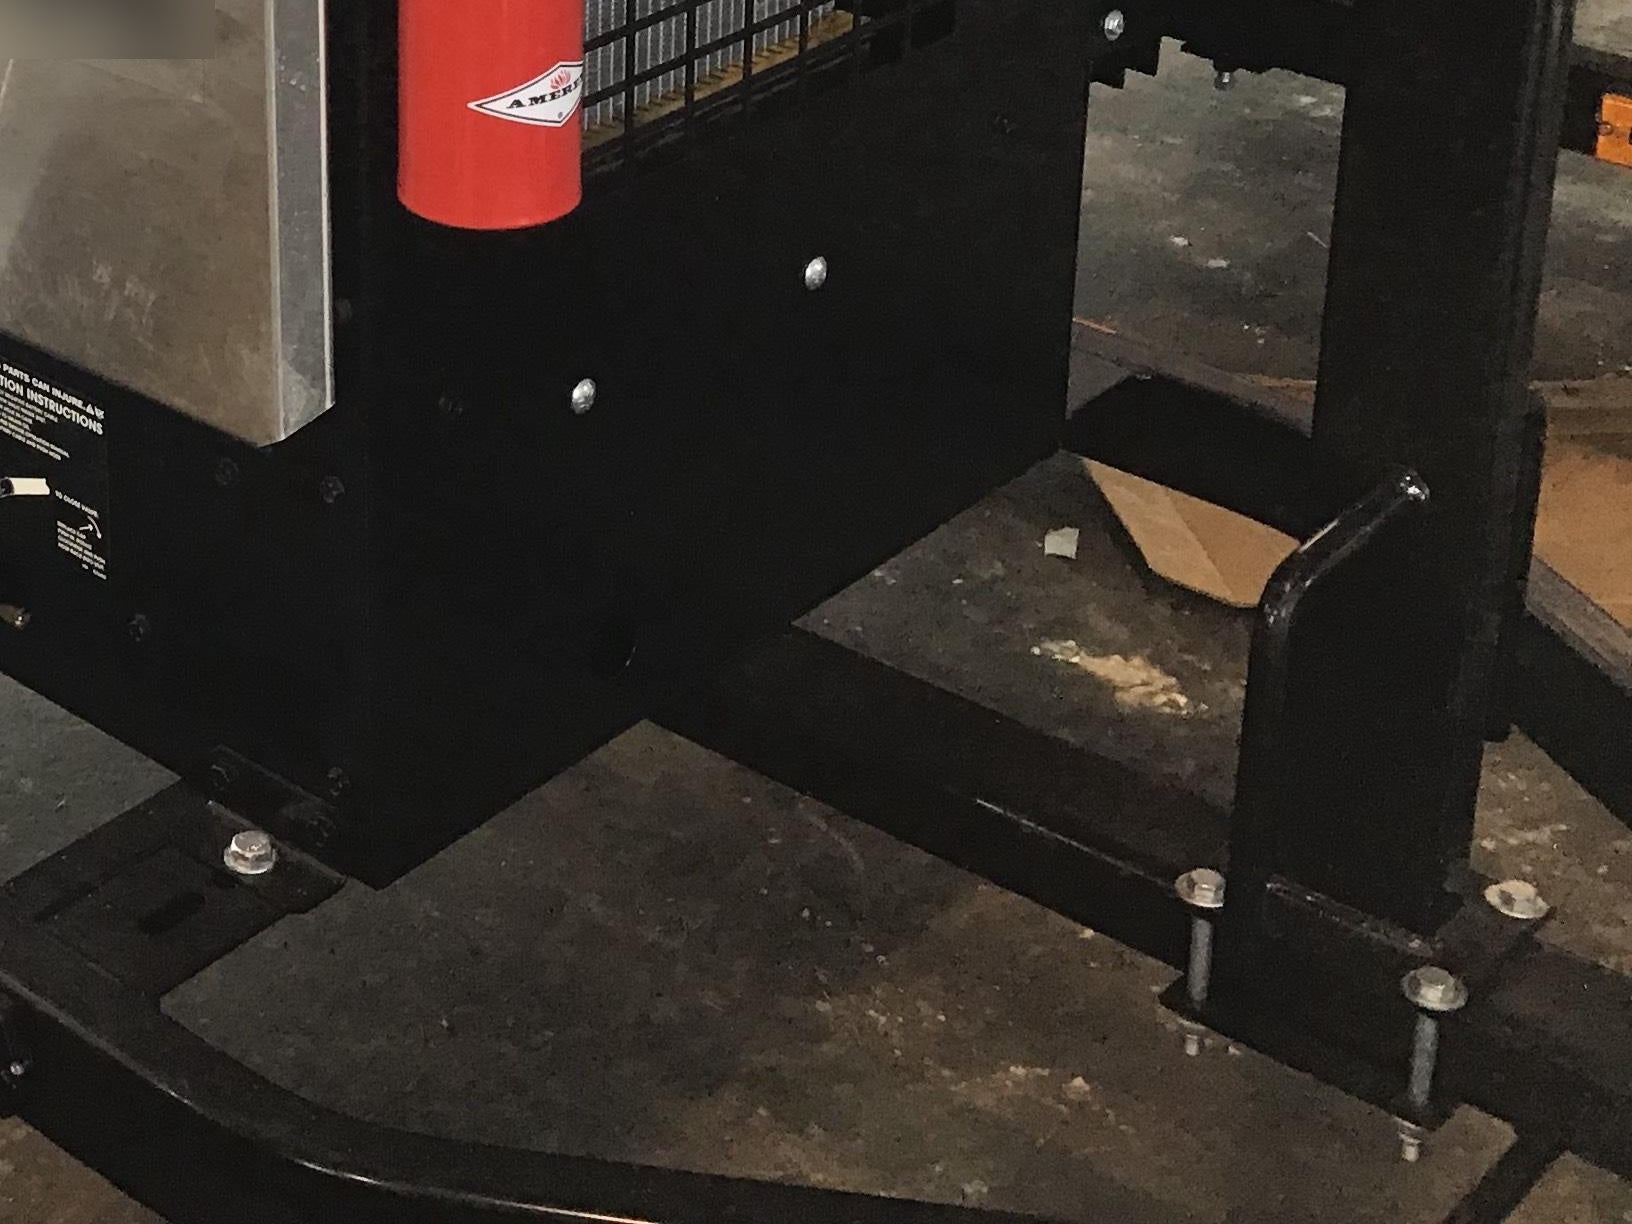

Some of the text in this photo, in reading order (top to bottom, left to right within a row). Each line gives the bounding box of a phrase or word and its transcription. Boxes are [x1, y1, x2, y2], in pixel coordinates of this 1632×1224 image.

[3, 363, 30, 383] PARTS
[32, 377, 50, 392] CAN
[27, 387, 104, 436] INSTRUCTIONS
